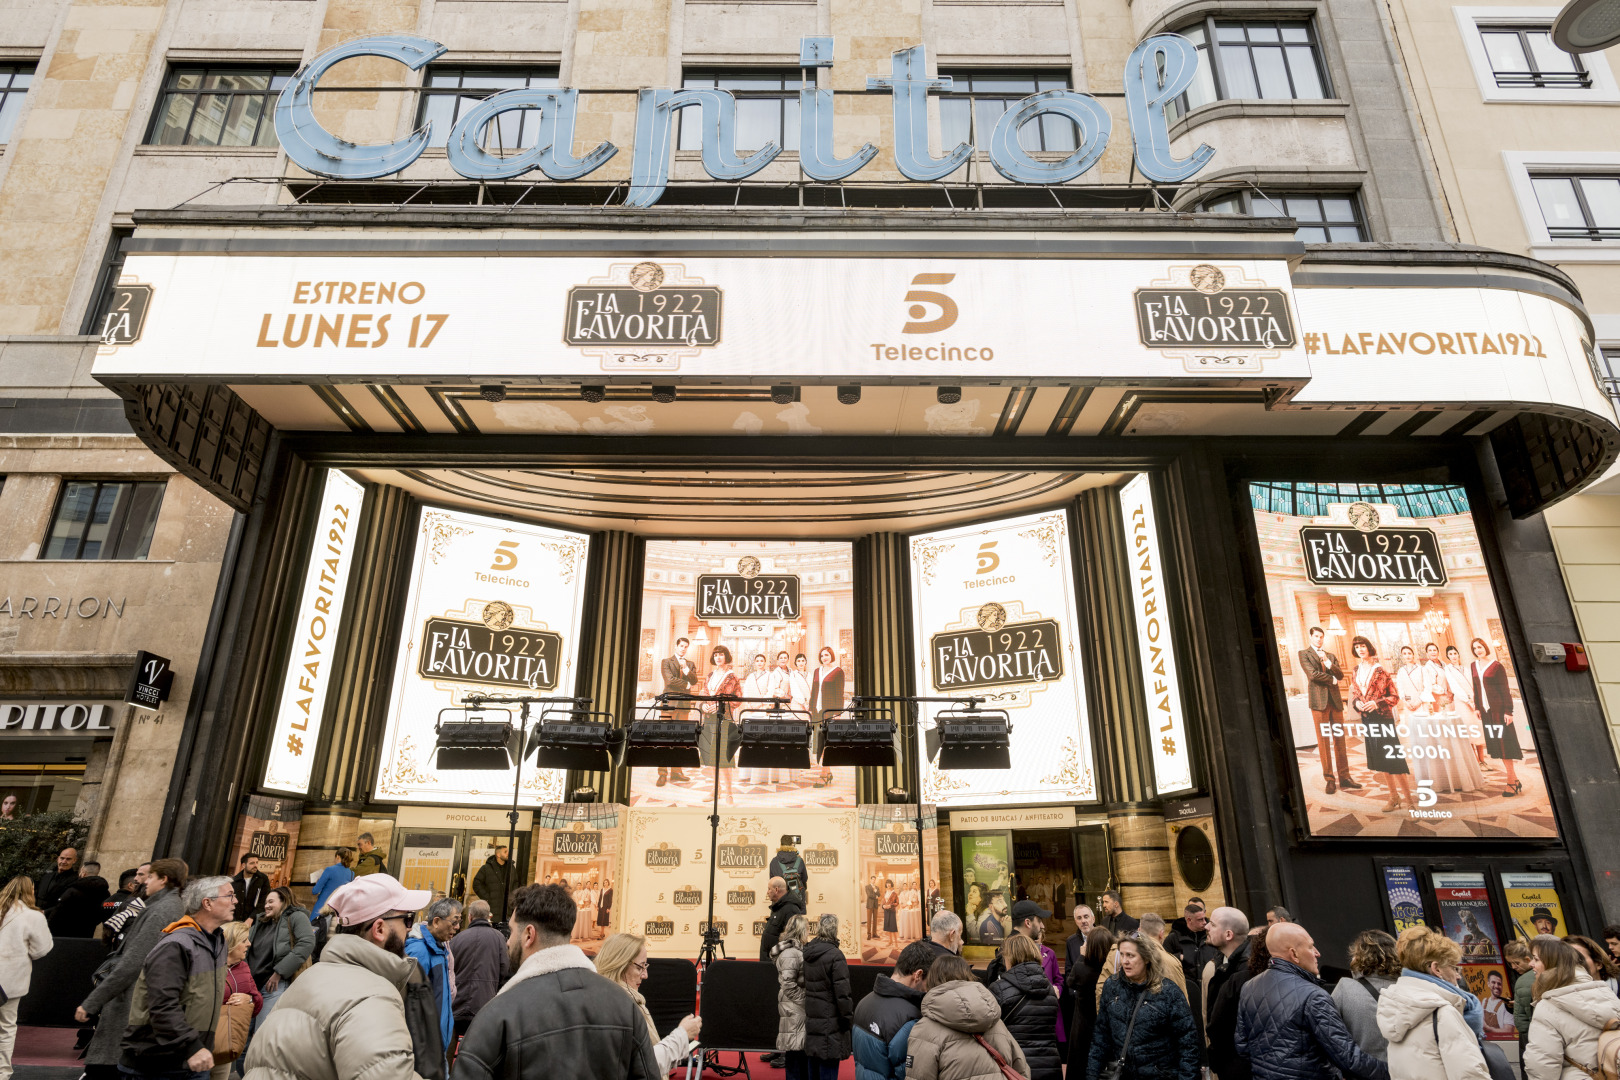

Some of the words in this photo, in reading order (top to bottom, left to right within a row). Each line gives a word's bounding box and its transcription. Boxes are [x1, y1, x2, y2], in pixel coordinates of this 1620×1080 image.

[274, 32, 1216, 208] Capitol
[292, 281, 426, 305] ESTRENO
[596, 291, 620, 315] LA
[637, 294, 704, 314] 1922
[1164, 295, 1190, 317] LA
[1204, 296, 1273, 317] 1922
[256, 313, 389, 349] LUNES
[408, 313, 450, 349] 17
[573, 299, 716, 346] FAVORITA
[1145, 302, 1288, 350] FAVORITA
[870, 342, 994, 362] Telecinco
[1303, 332, 1548, 360] #LAFAVORITA1922
[1325, 532, 1350, 554] LA
[1362, 534, 1424, 554] 1922
[1308, 538, 1440, 587] FAVORITA
[474, 571, 530, 588] Telecinco
[716, 579, 732, 595] LA
[744, 580, 788, 595] 1922
[963, 574, 1016, 590] Telecinco
[0, 596, 127, 619] ARRION
[702, 584, 794, 620] FAVORITA
[286, 503, 350, 757] #LAFAVORITA1922
[1131, 503, 1177, 757] #LAFAVORITA1922
[450, 626, 472, 650] LA
[489, 632, 546, 658] 1922
[952, 636, 974, 658] LA
[988, 628, 1044, 653] 1922
[426, 632, 550, 690] FAVORITA
[938, 645, 1055, 685] FAVORITA
[138, 684, 160, 697] VINCCI
[0, 703, 111, 730] PITOL
[154, 714, 164, 724] 41
[1320, 722, 1410, 738] ESTRENO
[1417, 723, 1482, 739] LUNES
[1484, 724, 1504, 740] 17
[1383, 744, 1452, 760] 23:00h
[446, 814, 487, 822] PHOTOCALL
[1408, 809, 1452, 818] Telecinco
[268, 836, 286, 846] 1922
[556, 836, 598, 854] FAVORITA
[575, 834, 597, 842] 1922
[877, 838, 920, 856] FAVORITA
[896, 834, 918, 842] 1922
[252, 837, 285, 862] FAVORITA
[648, 852, 679, 866] FAVORITA
[720, 850, 764, 868] FAVORITA
[740, 848, 762, 856] 1922
[806, 853, 836, 866] FAVORITA
